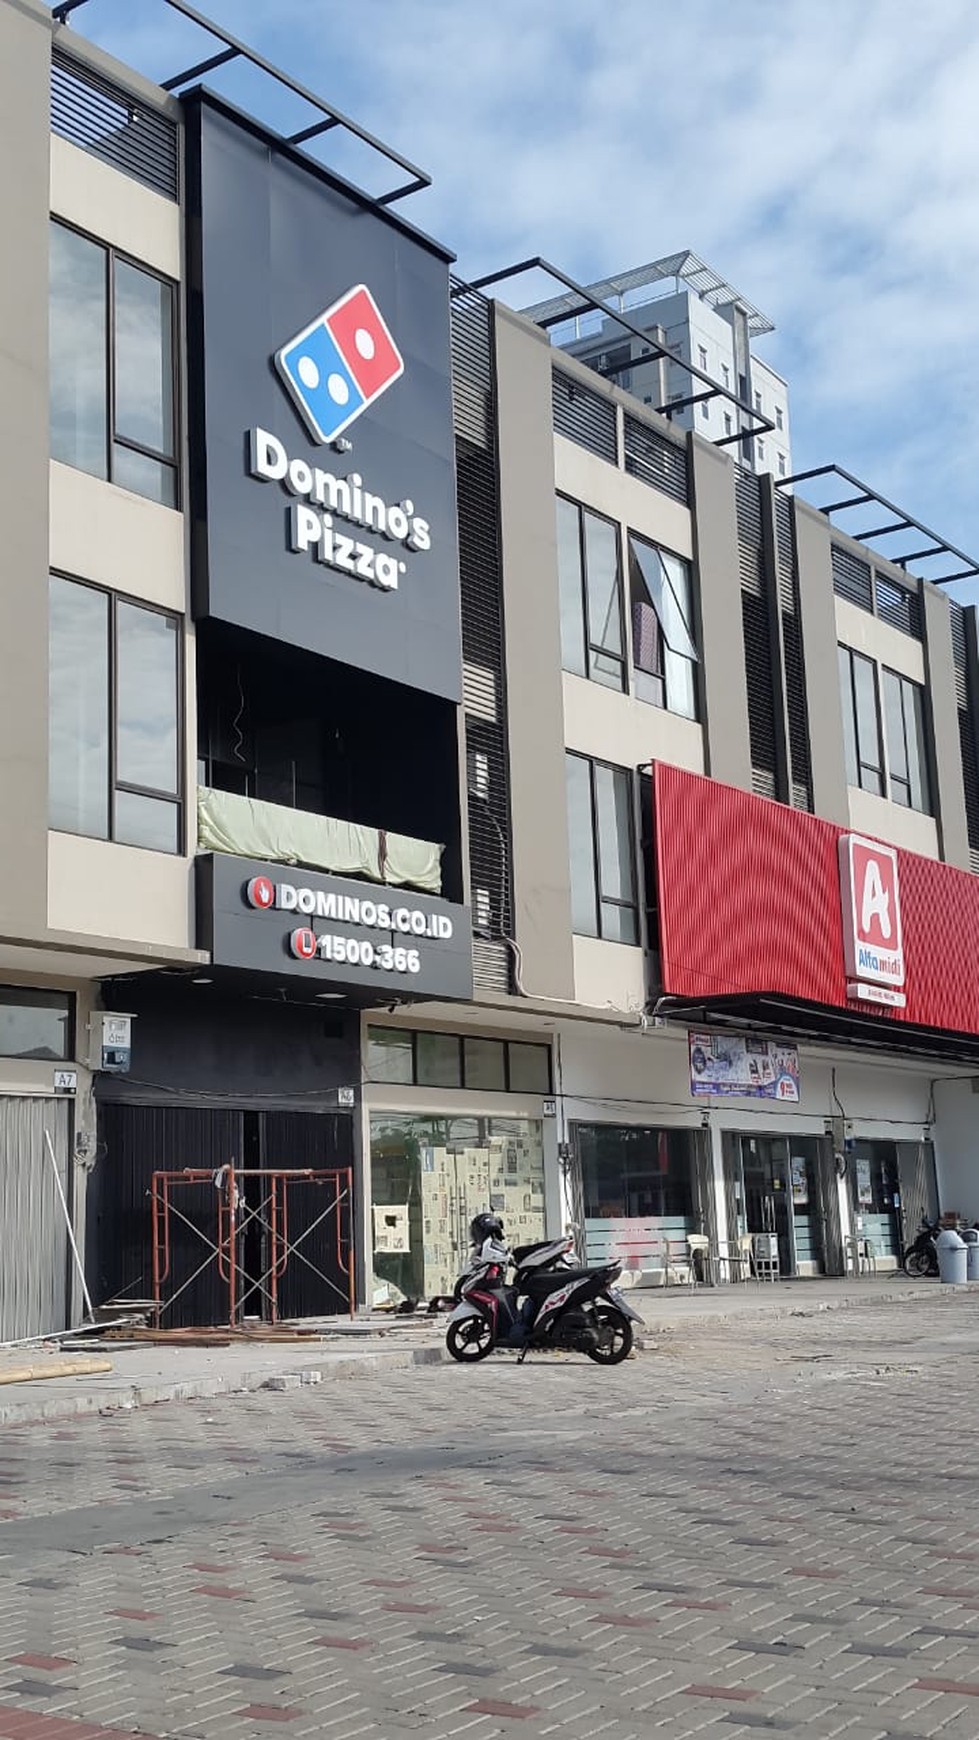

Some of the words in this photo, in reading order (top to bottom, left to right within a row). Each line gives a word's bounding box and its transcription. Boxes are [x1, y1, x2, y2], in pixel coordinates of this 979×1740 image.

[249, 427, 431, 551] Domino's
[291, 504, 400, 590] Pizza
[277, 884, 453, 939] DOMINOS.CO.ID
[58, 1074, 73, 1086] A7
